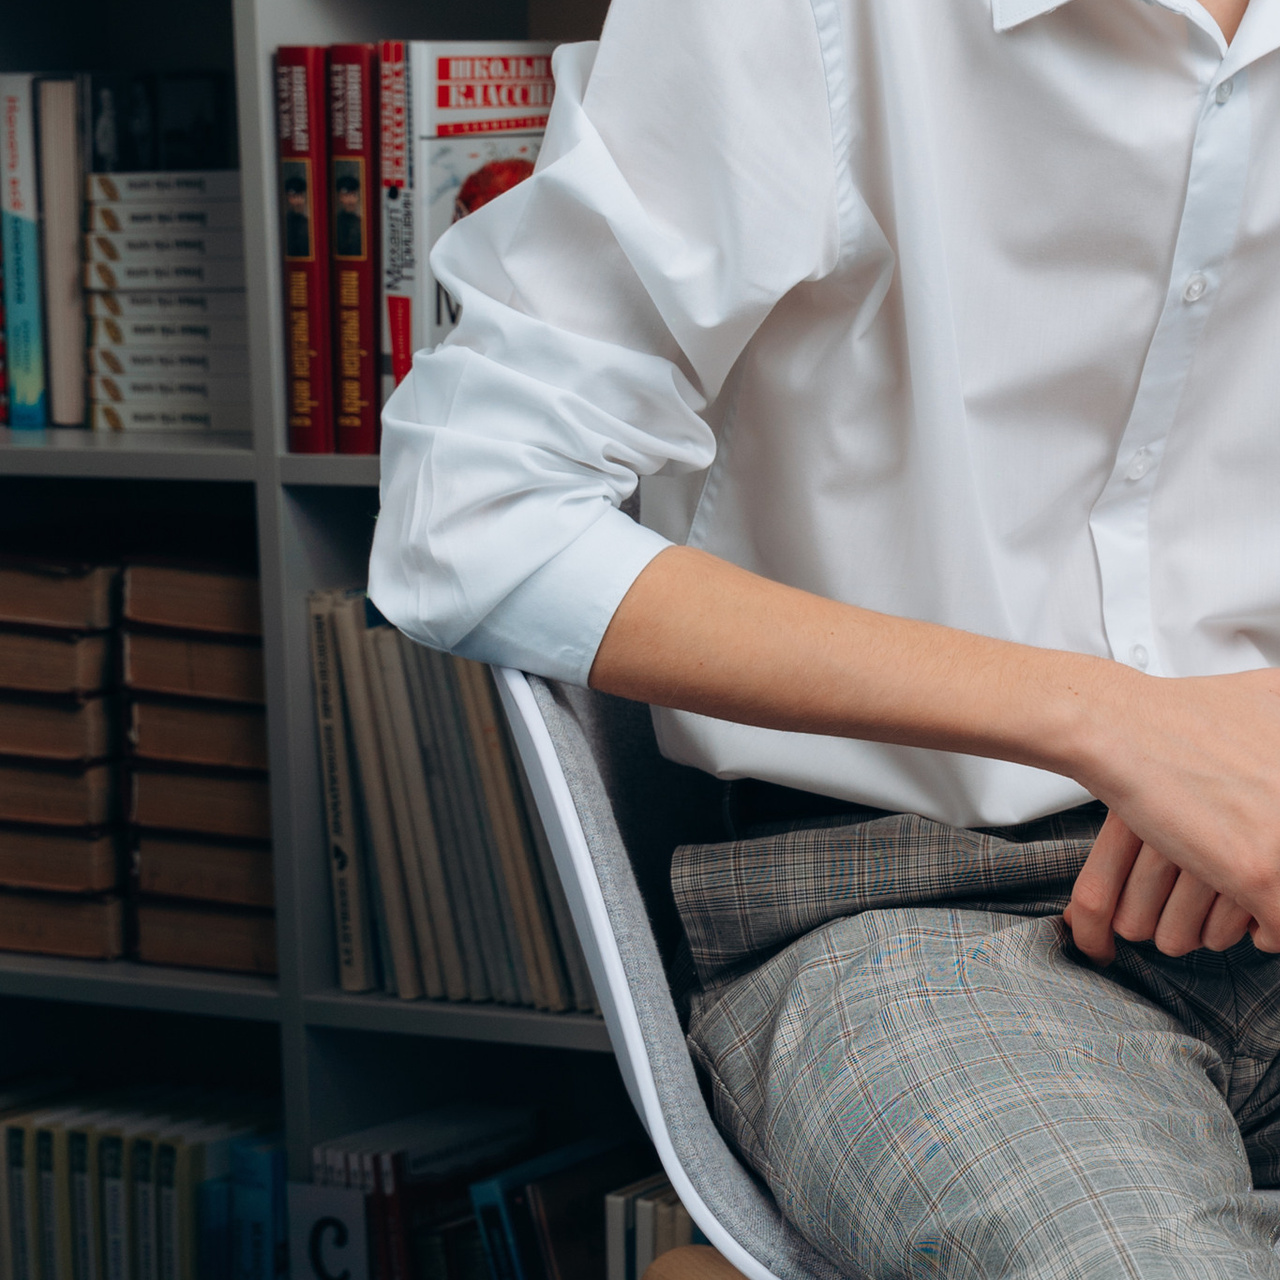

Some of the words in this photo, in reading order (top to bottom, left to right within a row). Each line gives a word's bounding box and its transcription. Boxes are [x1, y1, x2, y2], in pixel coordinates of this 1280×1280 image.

[450, 57, 547, 80] ШКОЛЬН
[385, 206, 401, 290] Михаил
[398, 192, 416, 280] Пришвин
[289, 270, 308, 306] птиц
[340, 270, 360, 305] птиц
[290, 309, 318, 377] непуганых
[340, 309, 368, 377] непуганых
[293, 380, 319, 413] краю
[342, 380, 370, 413] краю
